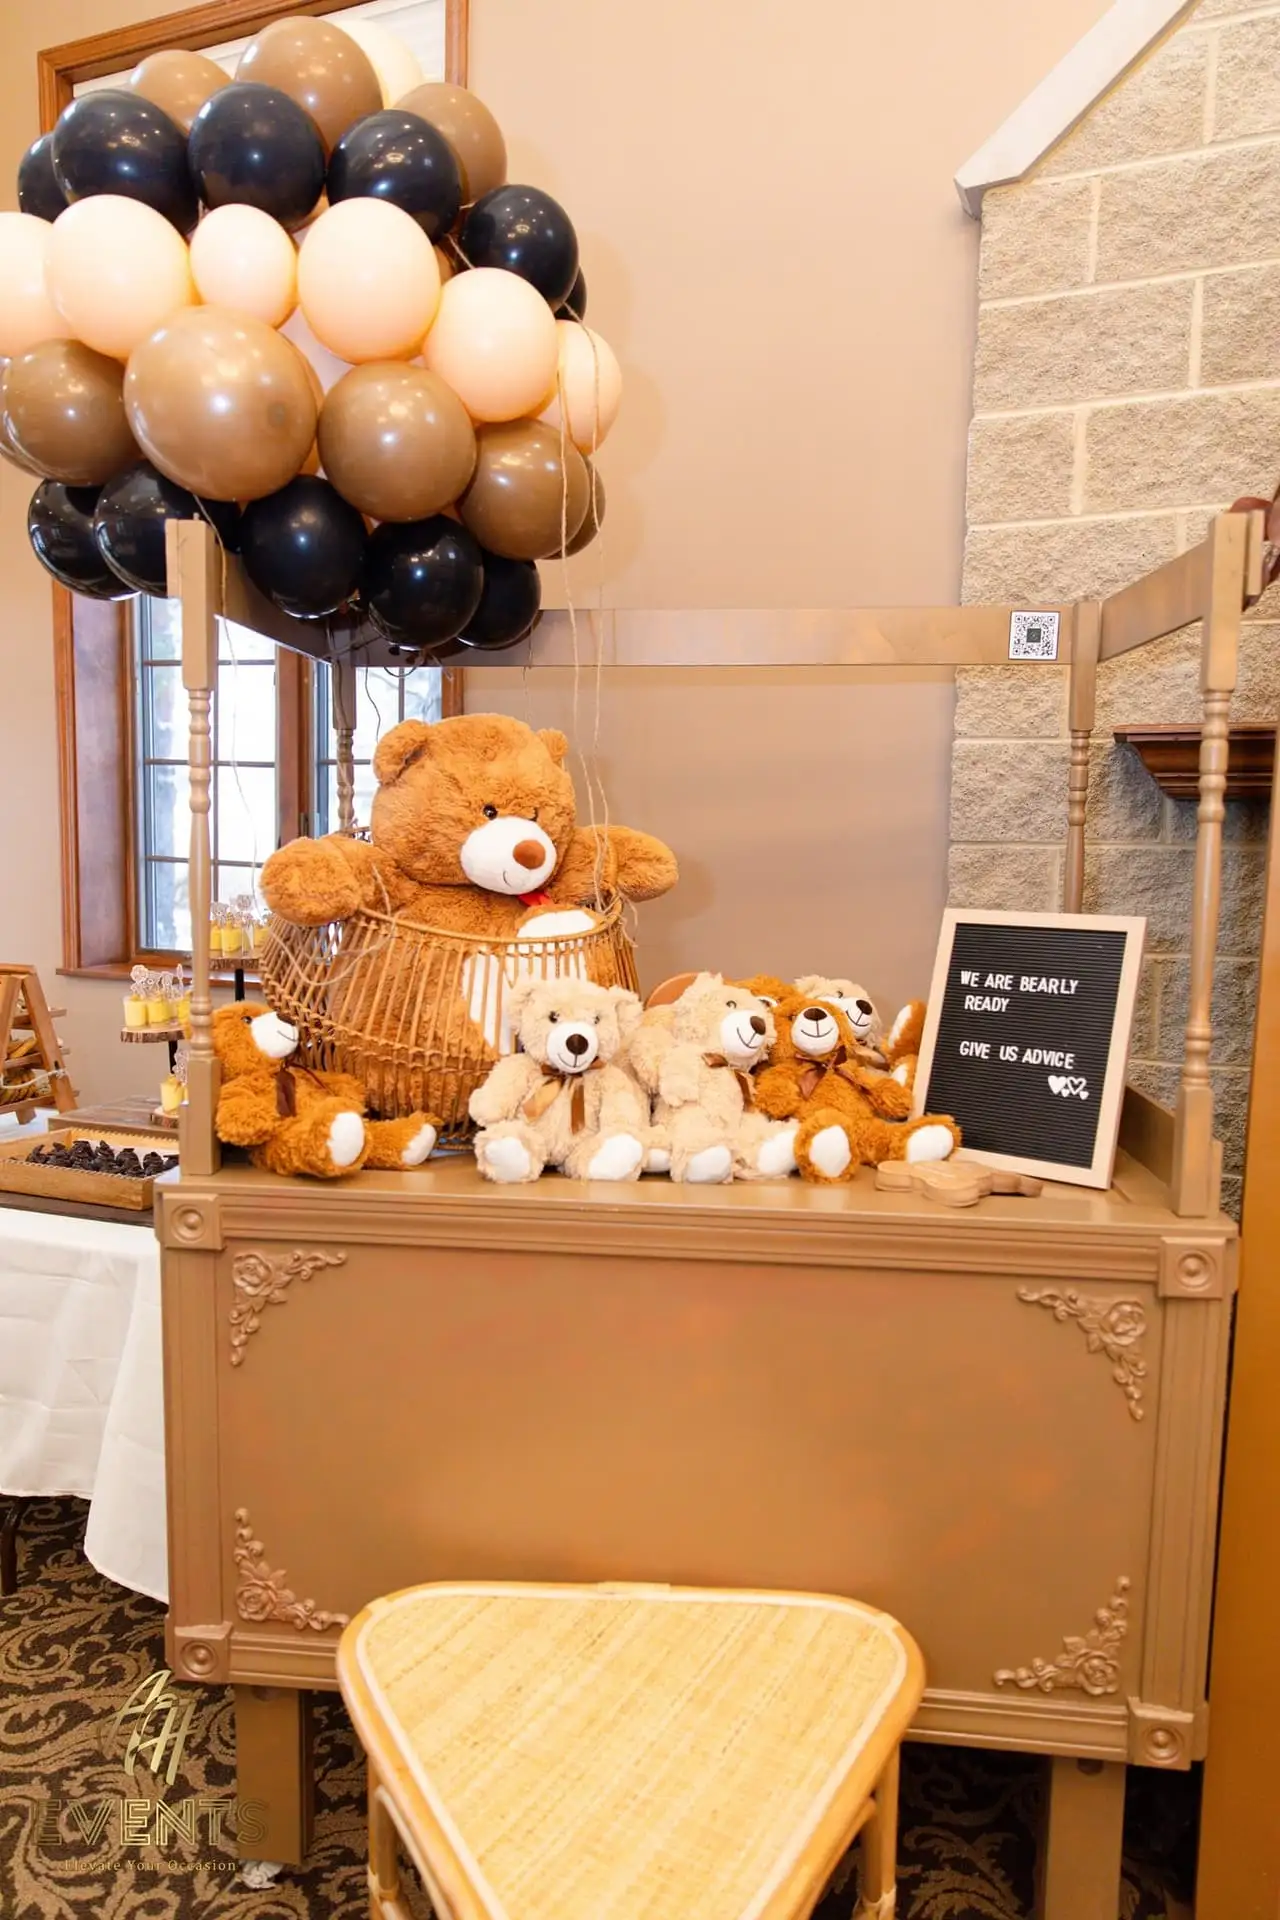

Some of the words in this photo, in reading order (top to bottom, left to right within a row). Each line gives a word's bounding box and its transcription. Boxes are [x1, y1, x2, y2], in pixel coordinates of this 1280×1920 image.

[961, 970, 980, 988] WE
[984, 973, 1014, 990] ARE
[1020, 976, 1079, 994] BEARLY
[964, 995, 1010, 1012] READY
[960, 1041, 990, 1059] GIVE
[1000, 1045, 1018, 1061] US
[1022, 1048, 1075, 1069] ADVICE
